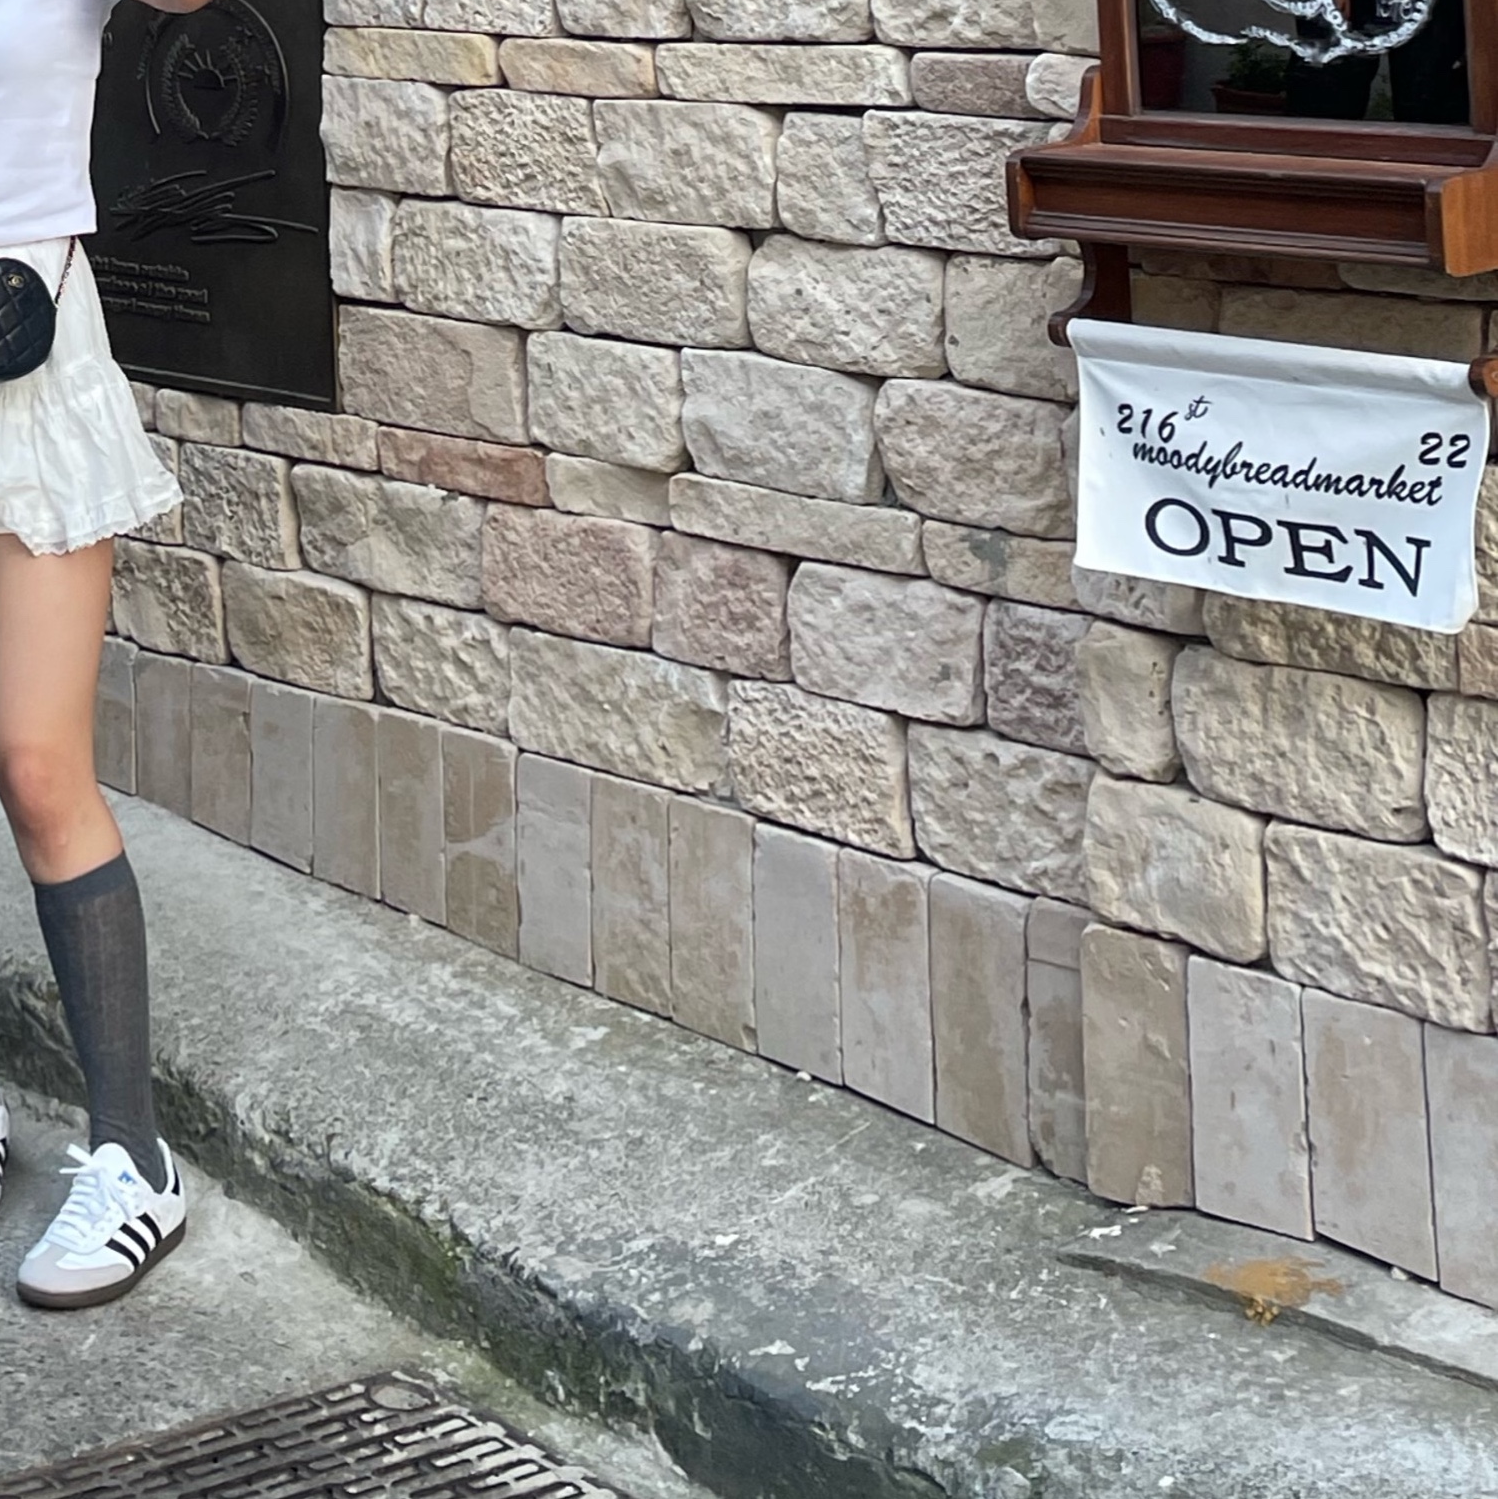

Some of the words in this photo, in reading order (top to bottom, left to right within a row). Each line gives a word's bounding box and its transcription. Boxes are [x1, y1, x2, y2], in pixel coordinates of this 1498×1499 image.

[1132, 440, 1443, 506] moodybreadmarket
[1418, 432, 1471, 468] 22
[1145, 497, 1432, 598] OPEN
